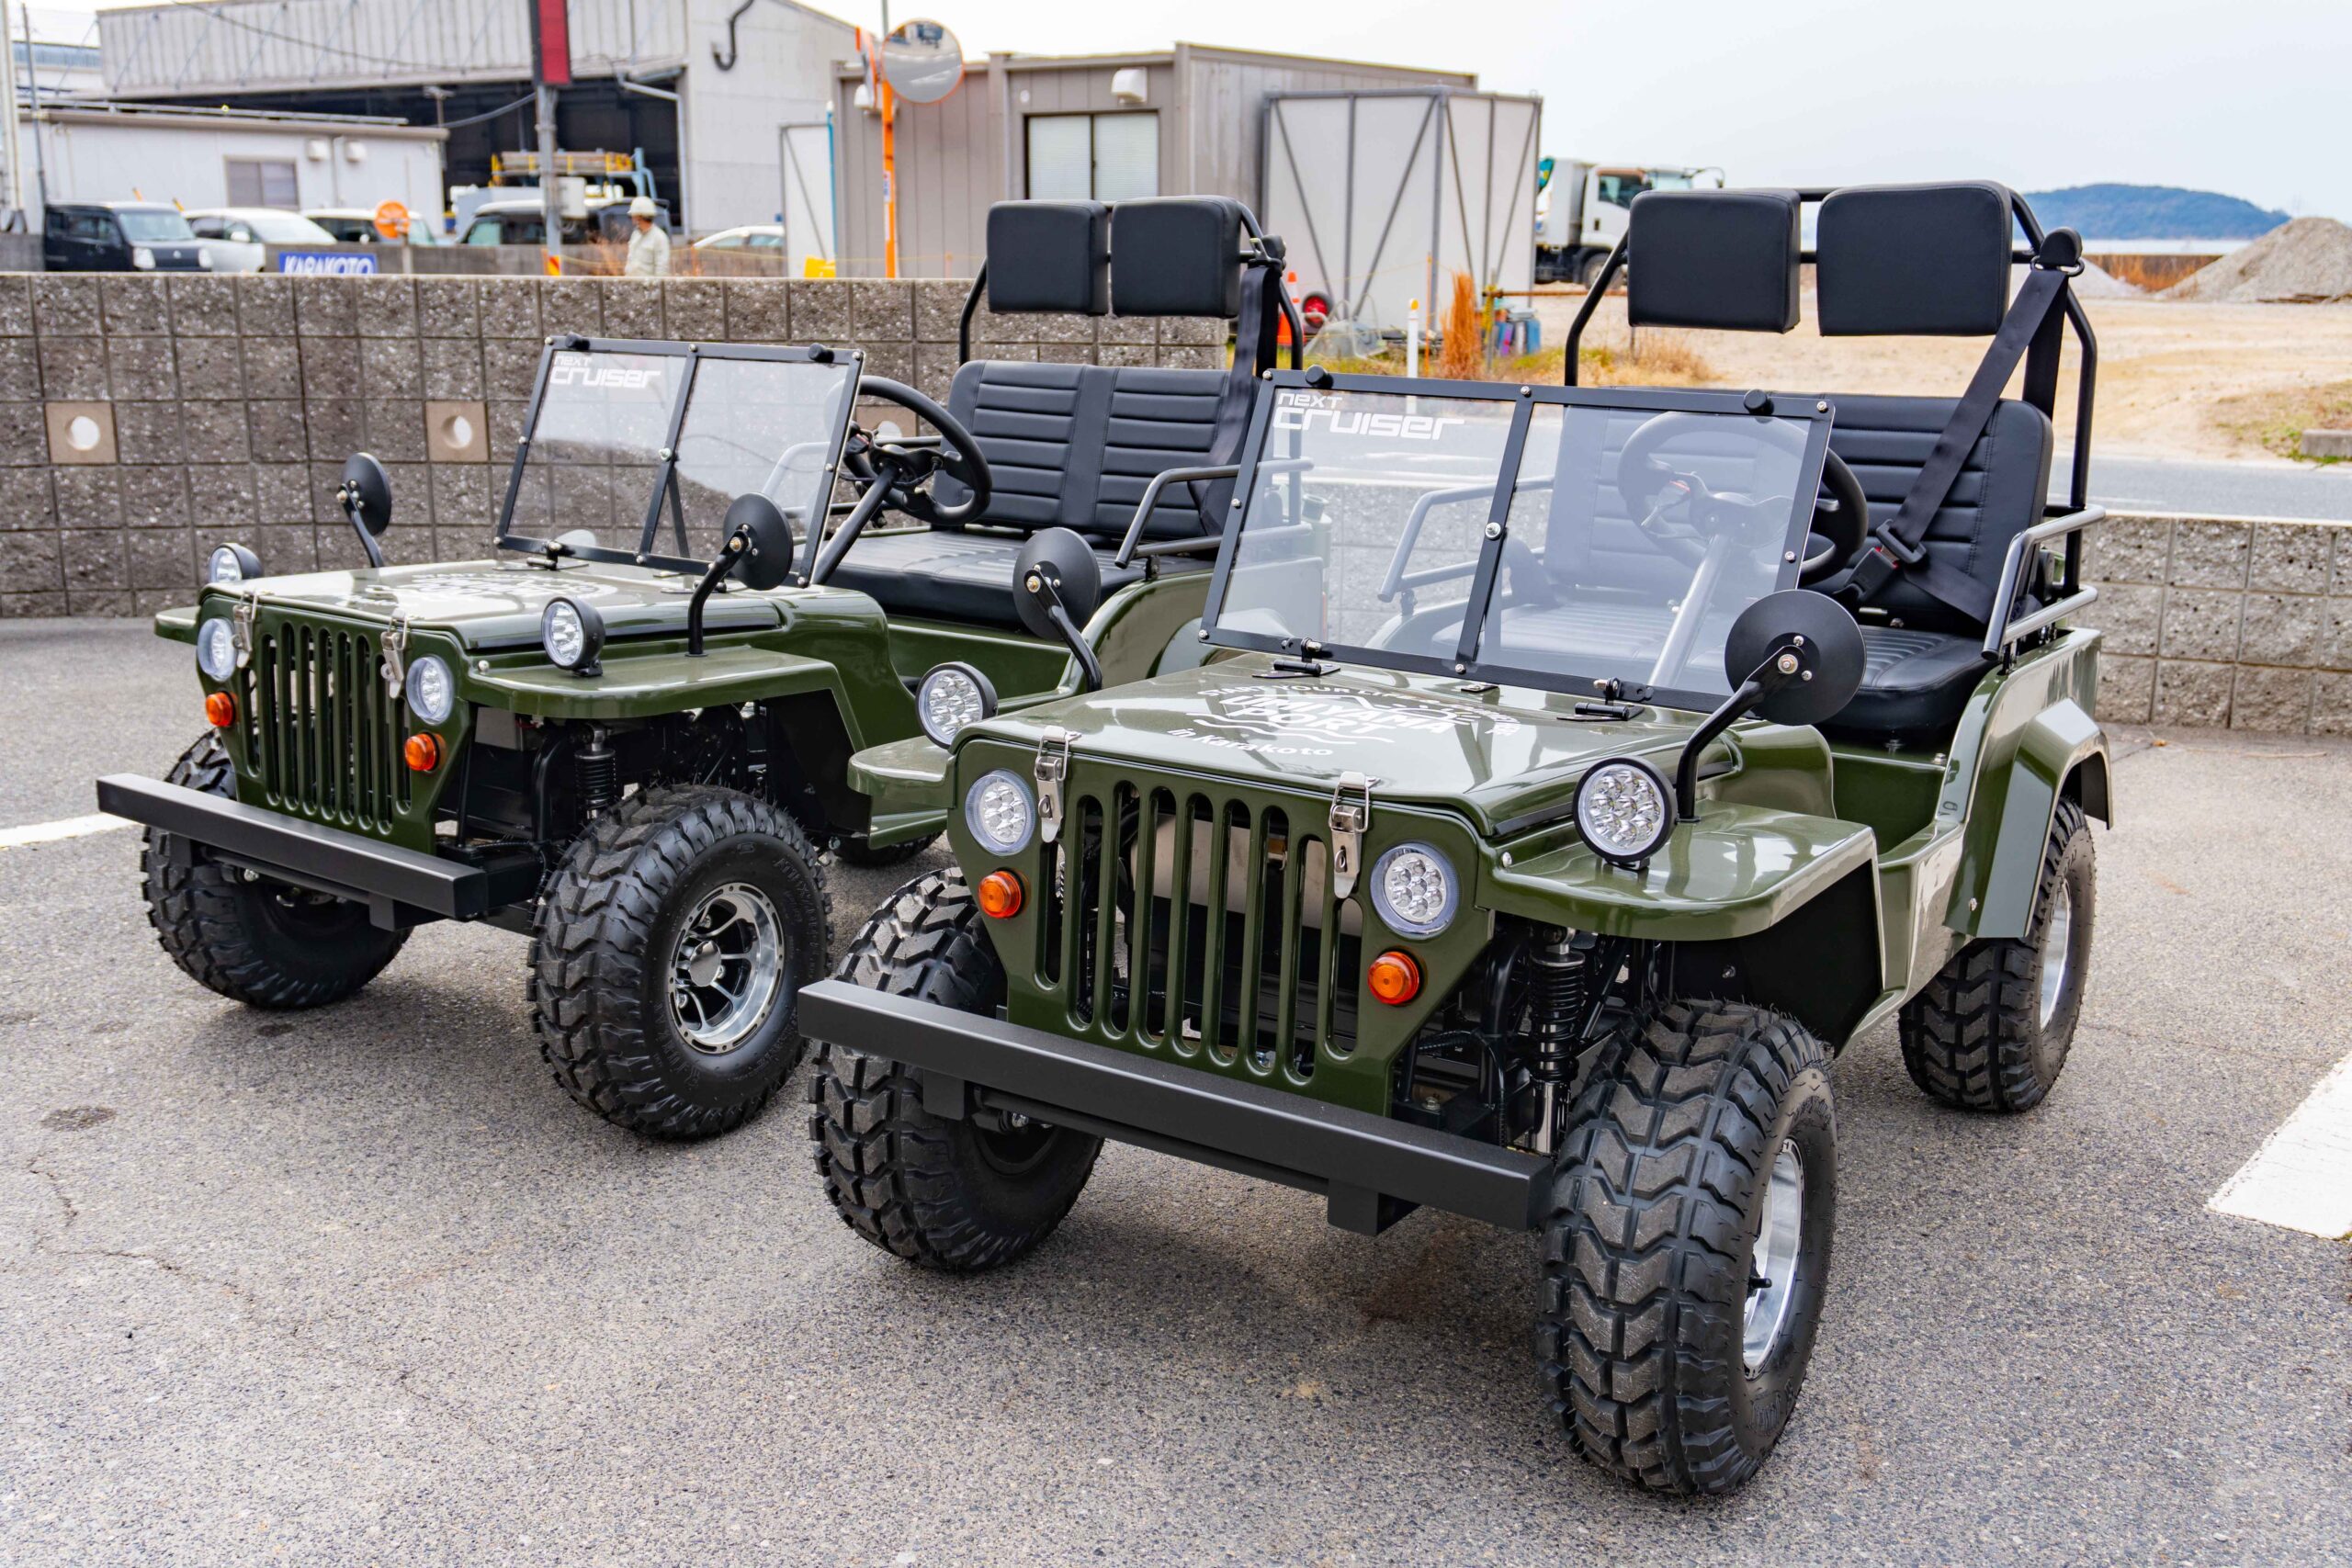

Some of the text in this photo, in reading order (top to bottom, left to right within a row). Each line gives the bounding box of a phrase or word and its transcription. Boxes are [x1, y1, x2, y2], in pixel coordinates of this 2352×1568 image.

[549, 367, 662, 389] cruiser
[1272, 406, 1465, 441] cruiser
[1272, 685, 1351, 694] YOUR
[1219, 695, 1456, 734] UMIYAMA
[1226, 706, 1396, 734] PORT
[1167, 728, 1333, 756] in Karakoto
